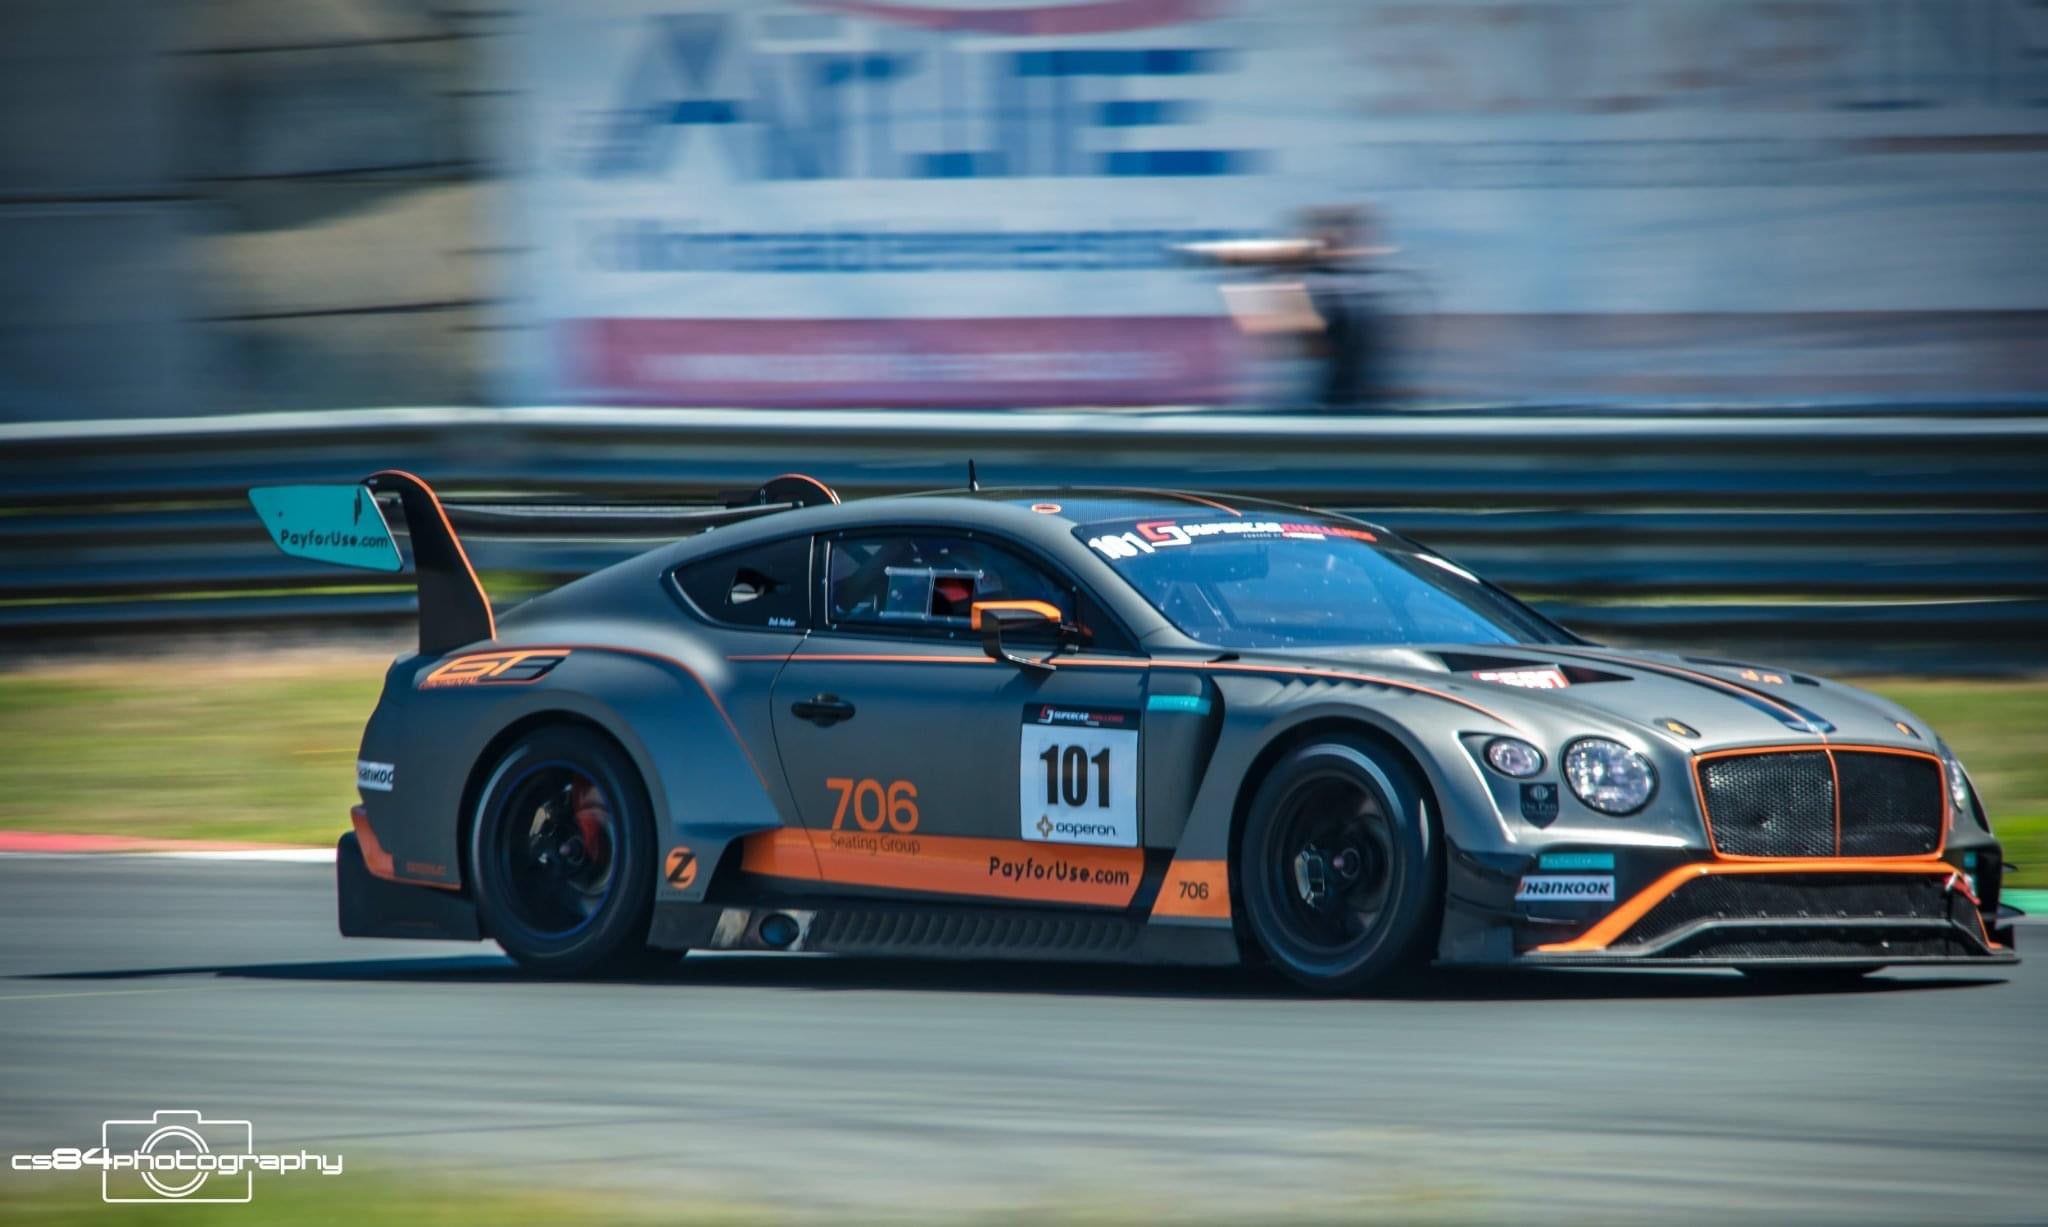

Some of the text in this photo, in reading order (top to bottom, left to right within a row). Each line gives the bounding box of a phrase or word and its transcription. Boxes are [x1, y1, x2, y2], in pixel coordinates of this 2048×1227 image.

[280, 528, 388, 549] PayforUse.com
[1039, 743, 1111, 809] 101
[826, 778, 919, 833] 706
[830, 831, 921, 857] Seating Group
[988, 856, 1130, 886] PayforUse.com
[1178, 881, 1209, 900] 706
